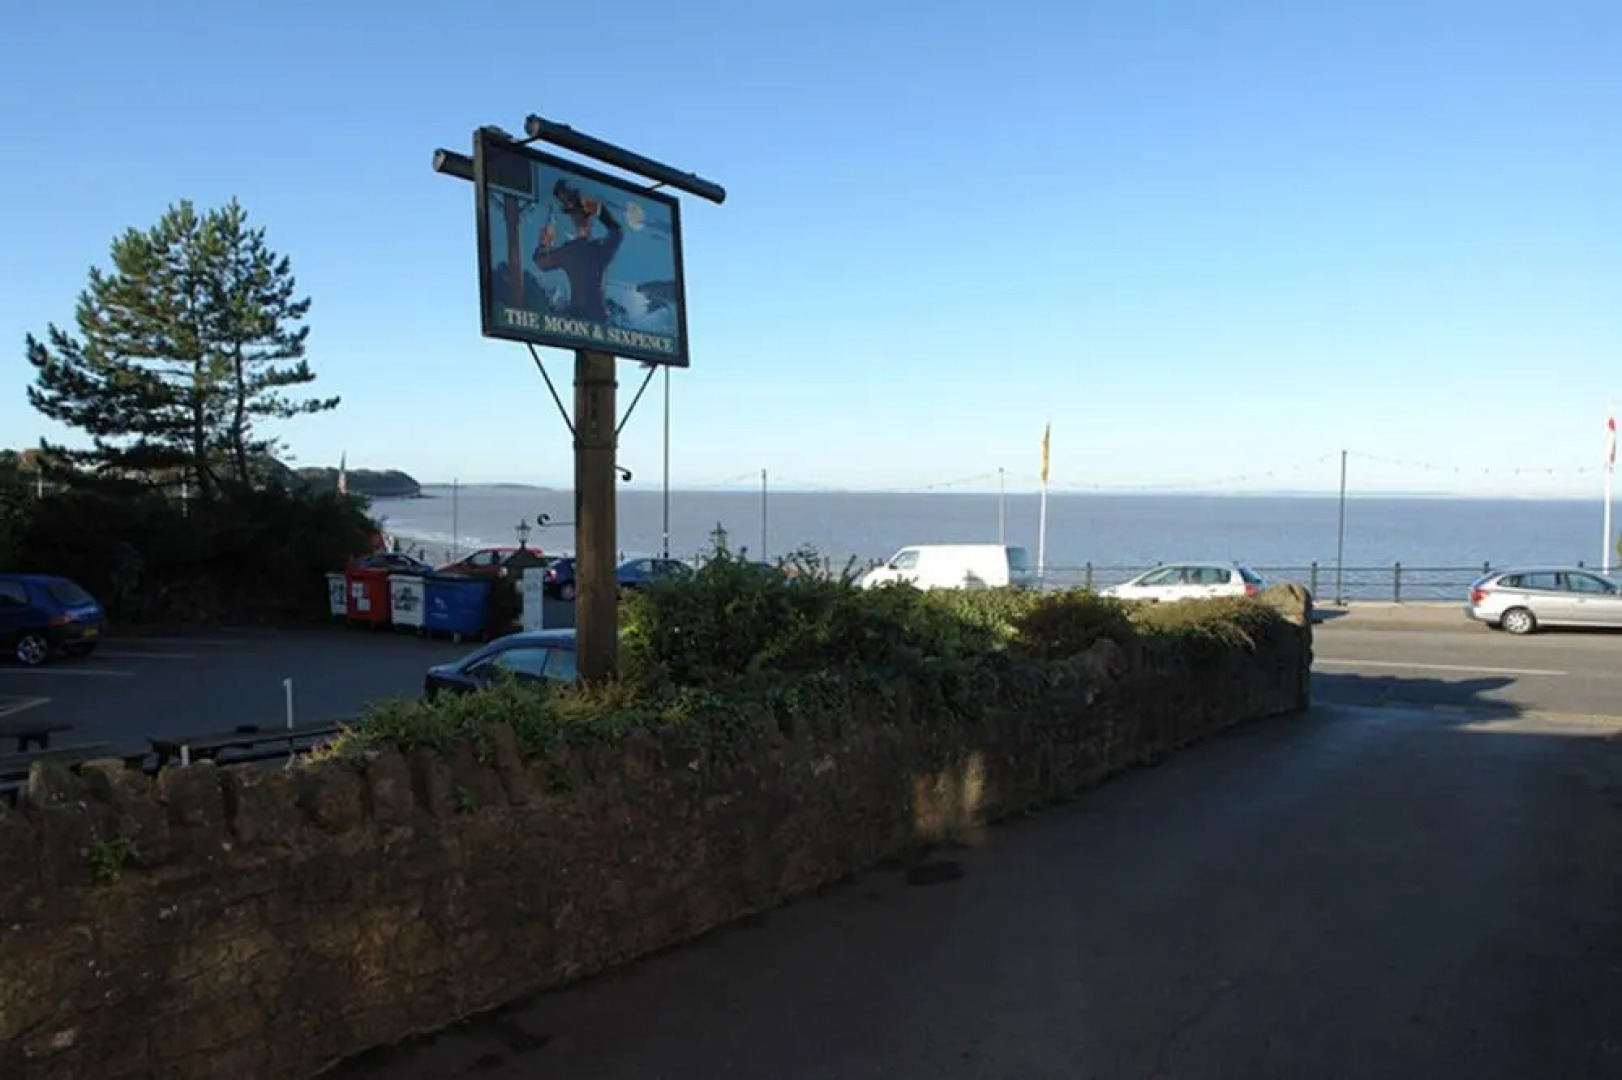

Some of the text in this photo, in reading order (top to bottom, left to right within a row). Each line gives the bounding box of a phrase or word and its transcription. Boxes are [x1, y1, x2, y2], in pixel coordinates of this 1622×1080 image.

[504, 308, 674, 352] THE MOON & SIXPENCE
